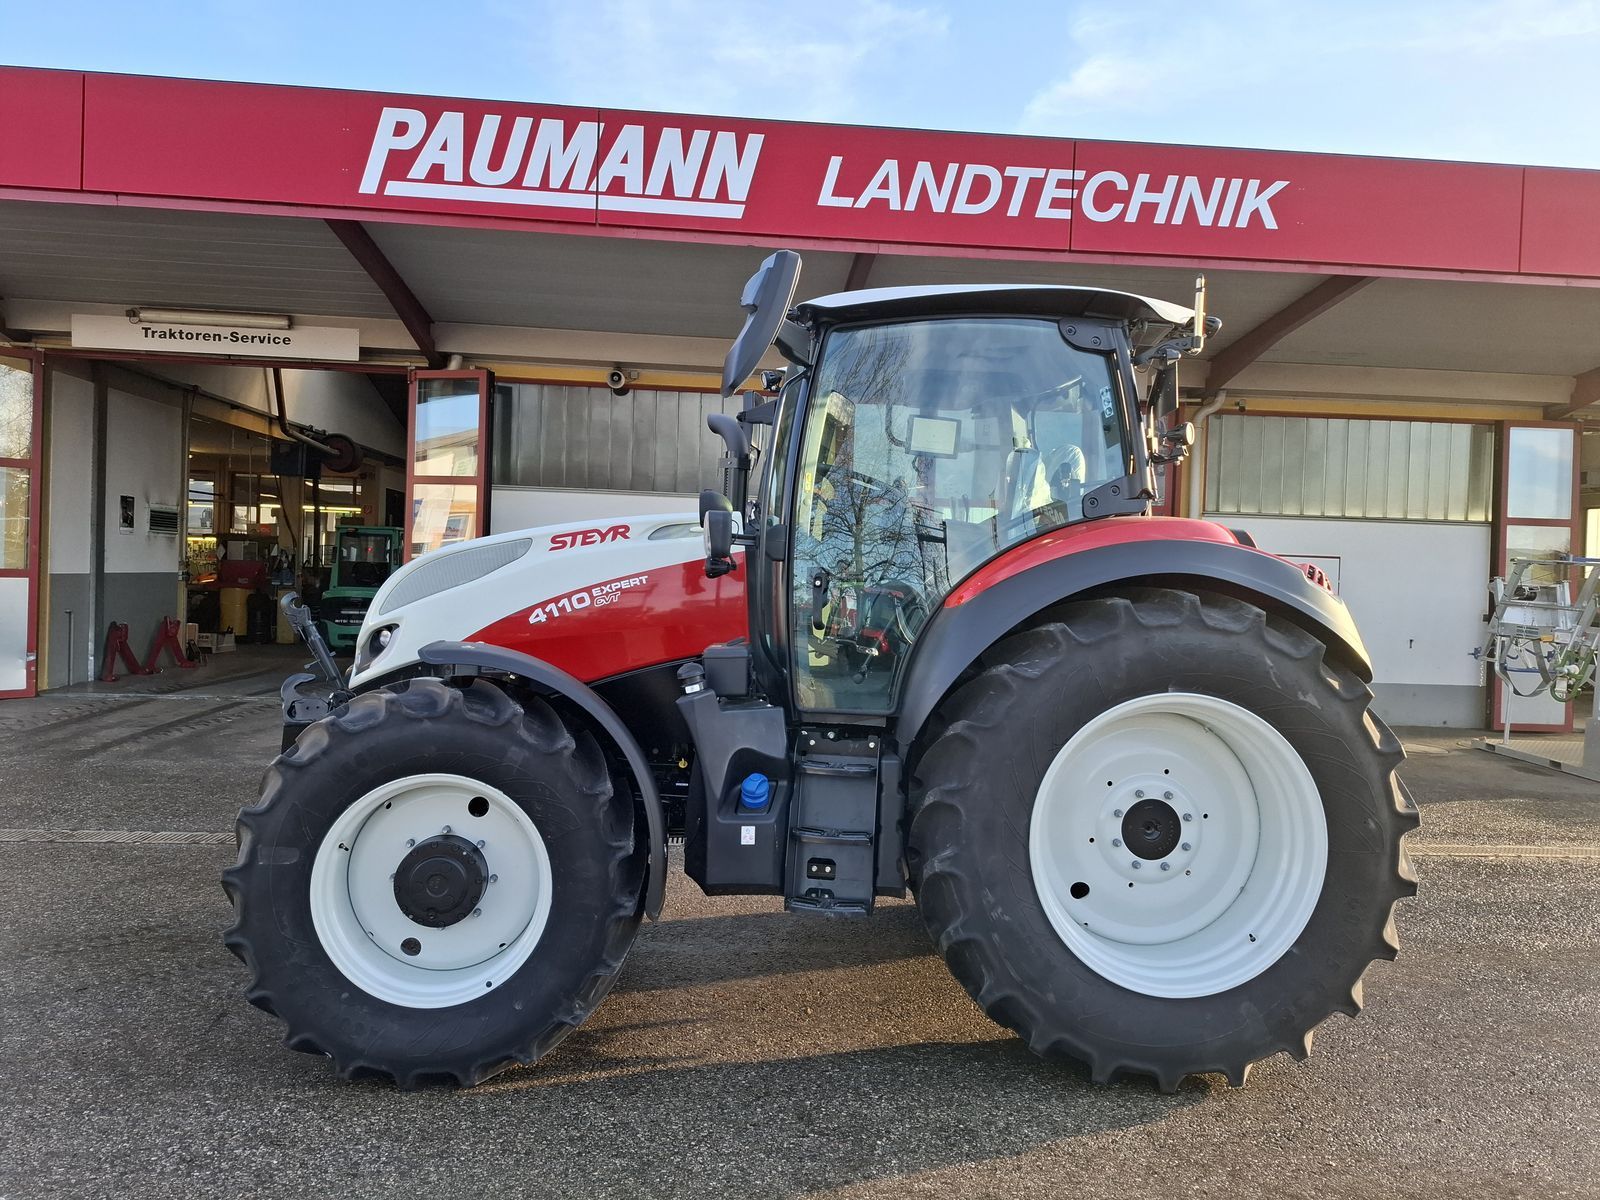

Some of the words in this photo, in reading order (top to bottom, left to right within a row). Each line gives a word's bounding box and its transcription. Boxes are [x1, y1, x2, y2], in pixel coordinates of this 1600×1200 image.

[358, 107, 765, 201] PAUMANN
[817, 156, 1290, 229] LANDTECHNIK
[142, 327, 291, 345] Traktoren-Service
[548, 524, 631, 552] STEYR
[528, 591, 591, 624] 4110
[592, 575, 648, 597] EXPERT
[594, 591, 621, 607] CVT
